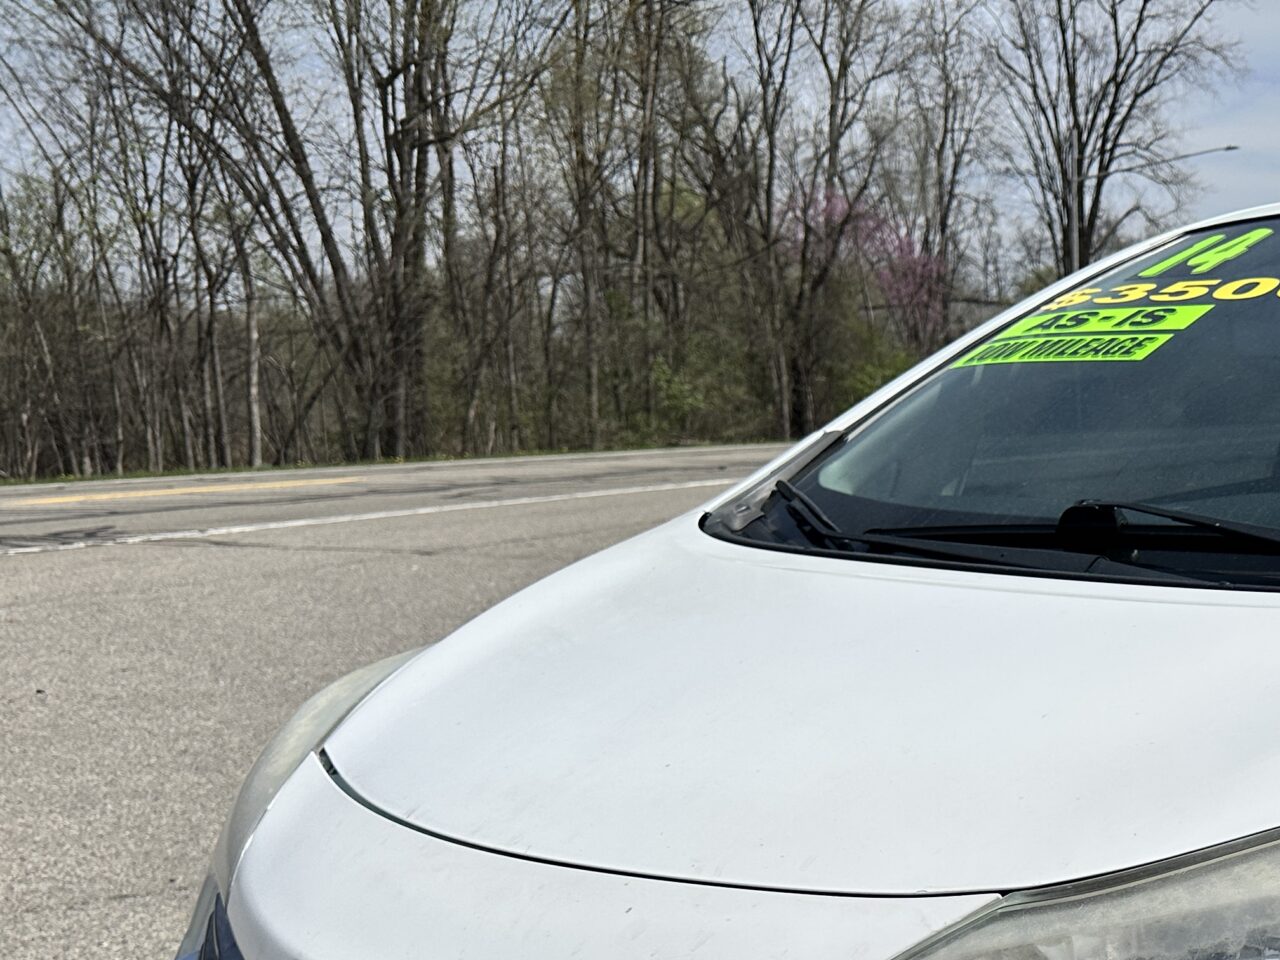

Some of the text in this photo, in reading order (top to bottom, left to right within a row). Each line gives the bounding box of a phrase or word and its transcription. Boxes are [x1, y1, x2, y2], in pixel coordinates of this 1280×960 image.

[1137, 227, 1274, 277] 14
[963, 336, 1160, 365] LOW MILEAGE
